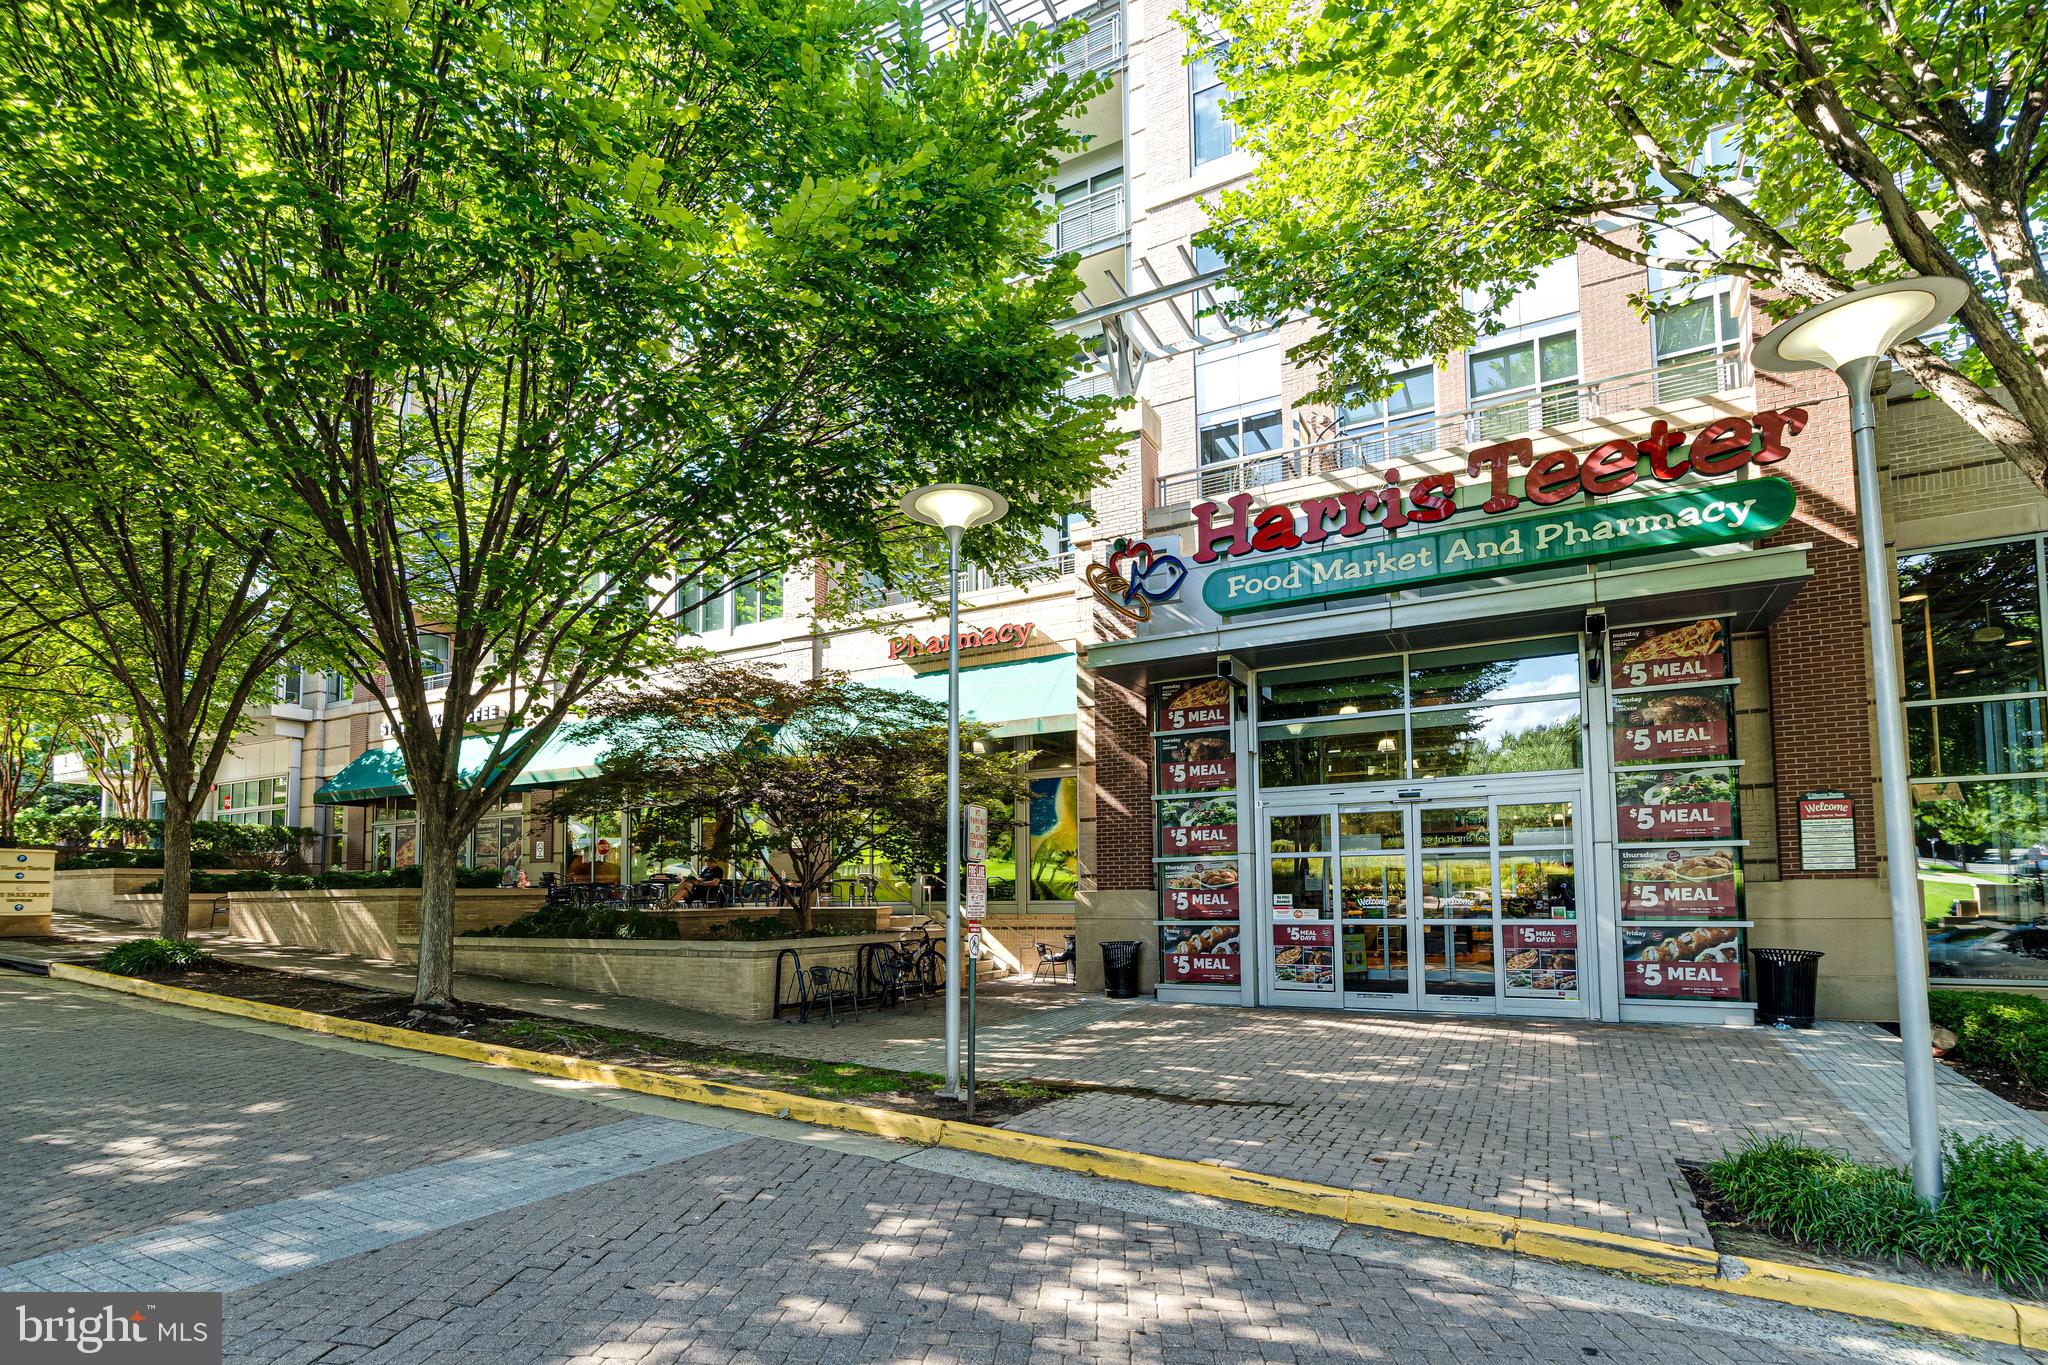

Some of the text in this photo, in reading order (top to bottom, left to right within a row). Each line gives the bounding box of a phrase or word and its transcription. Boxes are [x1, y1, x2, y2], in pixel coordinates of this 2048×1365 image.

[1192, 407, 1809, 564] Harris Teeter
[1228, 499, 1757, 598] Food Market And Pharmacy
[888, 622, 1035, 660] Pharmacy
[1613, 631, 1640, 639] monday
[1622, 661, 1707, 686] $5 MEAL
[1168, 709, 1224, 728] $5 MEAL
[1626, 729, 1651, 751] $5
[1656, 727, 1711, 743] MEAL
[1169, 764, 1225, 782] $5 MEAL
[1804, 801, 1849, 813] Welcome
[1629, 807, 1715, 830] $5 MEAL
[1170, 829, 1227, 847] $5 MEAL
[1172, 892, 1228, 910] $5 MEAL
[1357, 896, 1390, 907] Welcome
[1633, 885, 1719, 907] $5 MEAL
[1286, 927, 1301, 940] $5
[1520, 927, 1536, 942] $5
[1626, 930, 1646, 938] friday
[1173, 955, 1230, 974] $5 MEAL
[1636, 963, 1723, 986] $5 MEAL
